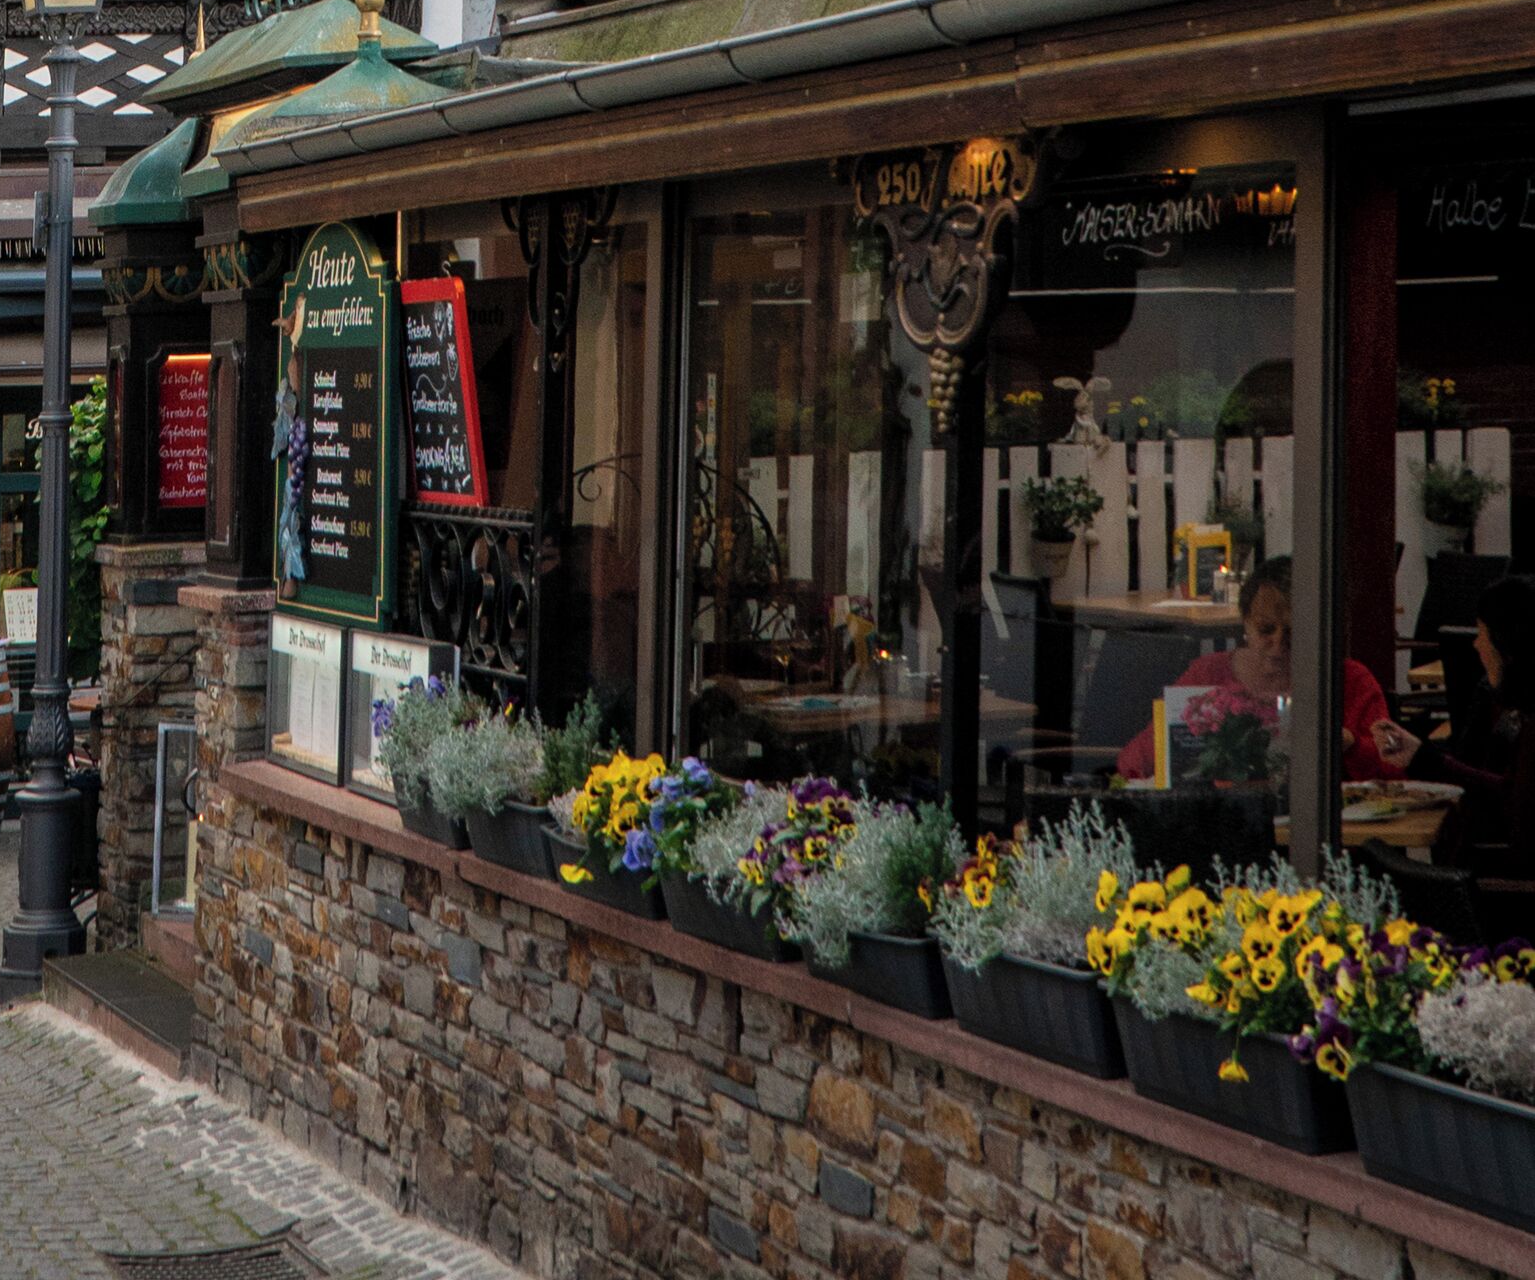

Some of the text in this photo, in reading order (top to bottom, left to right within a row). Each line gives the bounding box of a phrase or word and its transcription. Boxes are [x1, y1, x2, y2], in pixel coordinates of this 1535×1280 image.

[876, 160, 920, 206] 250
[1425, 179, 1508, 233] Halbe
[307, 245, 355, 290] Heute
[307, 296, 374, 336] zu empfehlen:
[289, 627, 298, 646] Der
[370, 645, 381, 665] Der
